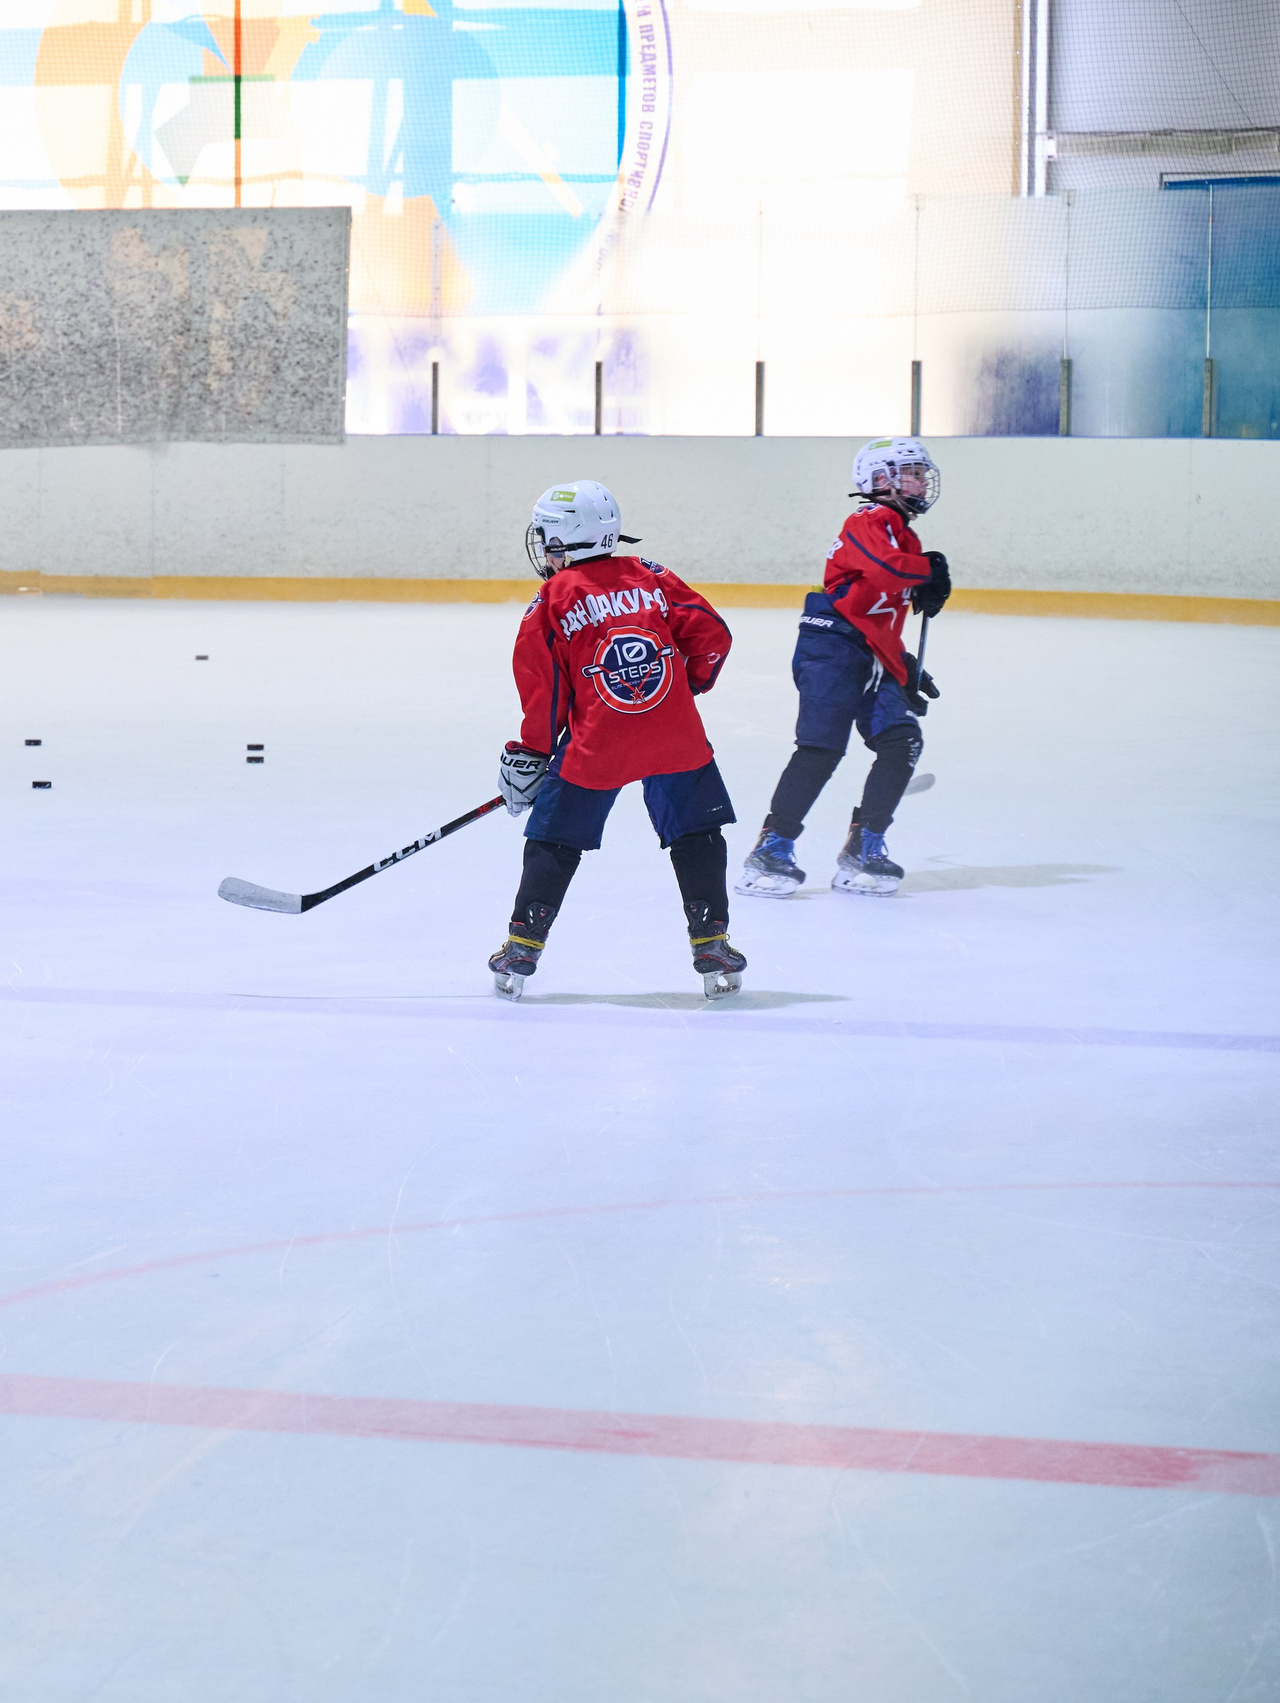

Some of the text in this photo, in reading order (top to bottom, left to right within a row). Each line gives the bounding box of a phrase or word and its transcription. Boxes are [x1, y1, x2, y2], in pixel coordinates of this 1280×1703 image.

[638, 23, 657, 114] ПРЕДМЕТОВ
[601, 533, 614, 549] 46
[800, 616, 834, 628] AUER
[613, 641, 647, 666] 10
[608, 660, 662, 684] STEPS
[373, 828, 442, 872] CCM
